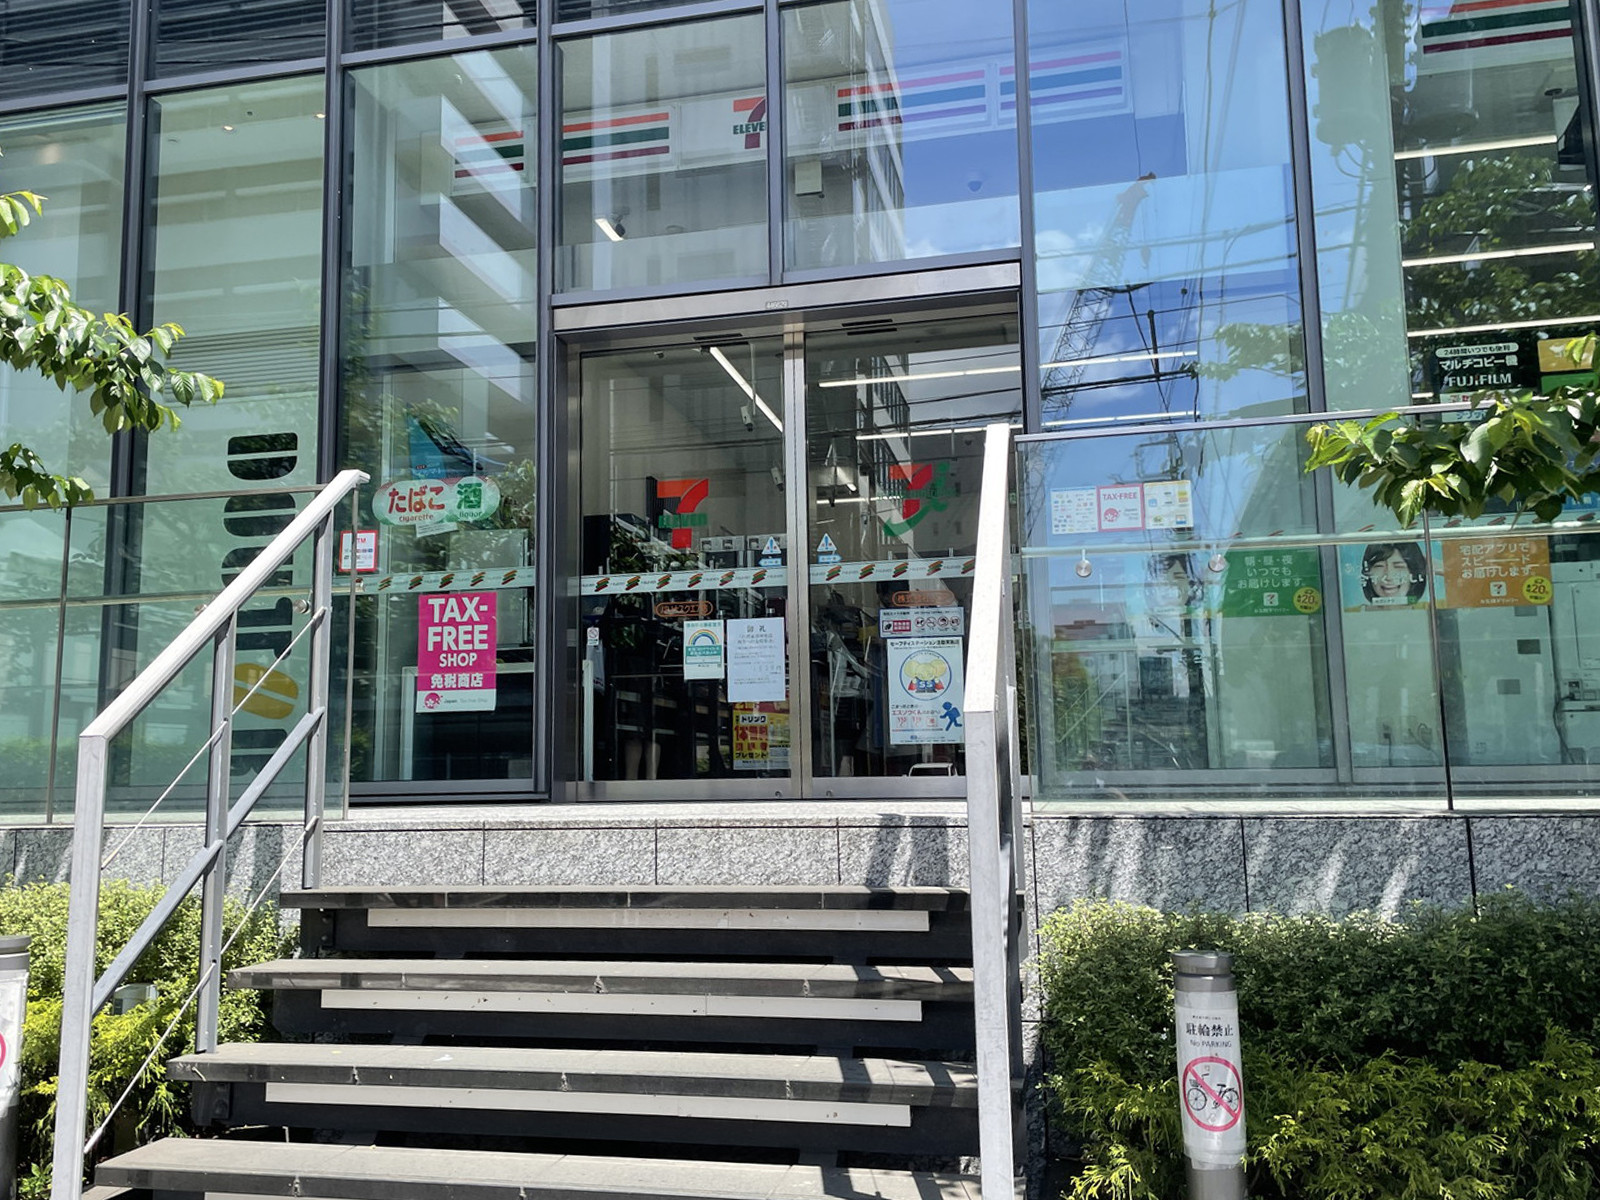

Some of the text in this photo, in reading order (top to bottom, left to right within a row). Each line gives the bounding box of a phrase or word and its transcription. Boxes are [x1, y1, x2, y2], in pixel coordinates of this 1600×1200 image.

[733, 121, 766, 135] ELEVE
[1439, 354, 1519, 371] マルチコピー機
[1448, 373, 1512, 387] FUJIFILM
[388, 485, 445, 514] たばこ
[456, 482, 483, 510] 酒
[657, 478, 710, 549] 7
[1459, 542, 1530, 556] 宅配アプリで
[1246, 566, 1292, 577] いつでも
[427, 597, 489, 623] TAX-
[427, 624, 489, 652] FREE
[439, 652, 478, 668] SHOP
[430, 672, 484, 689] 免税商店
[1186, 1022, 1234, 1038] 駐輪禁止
